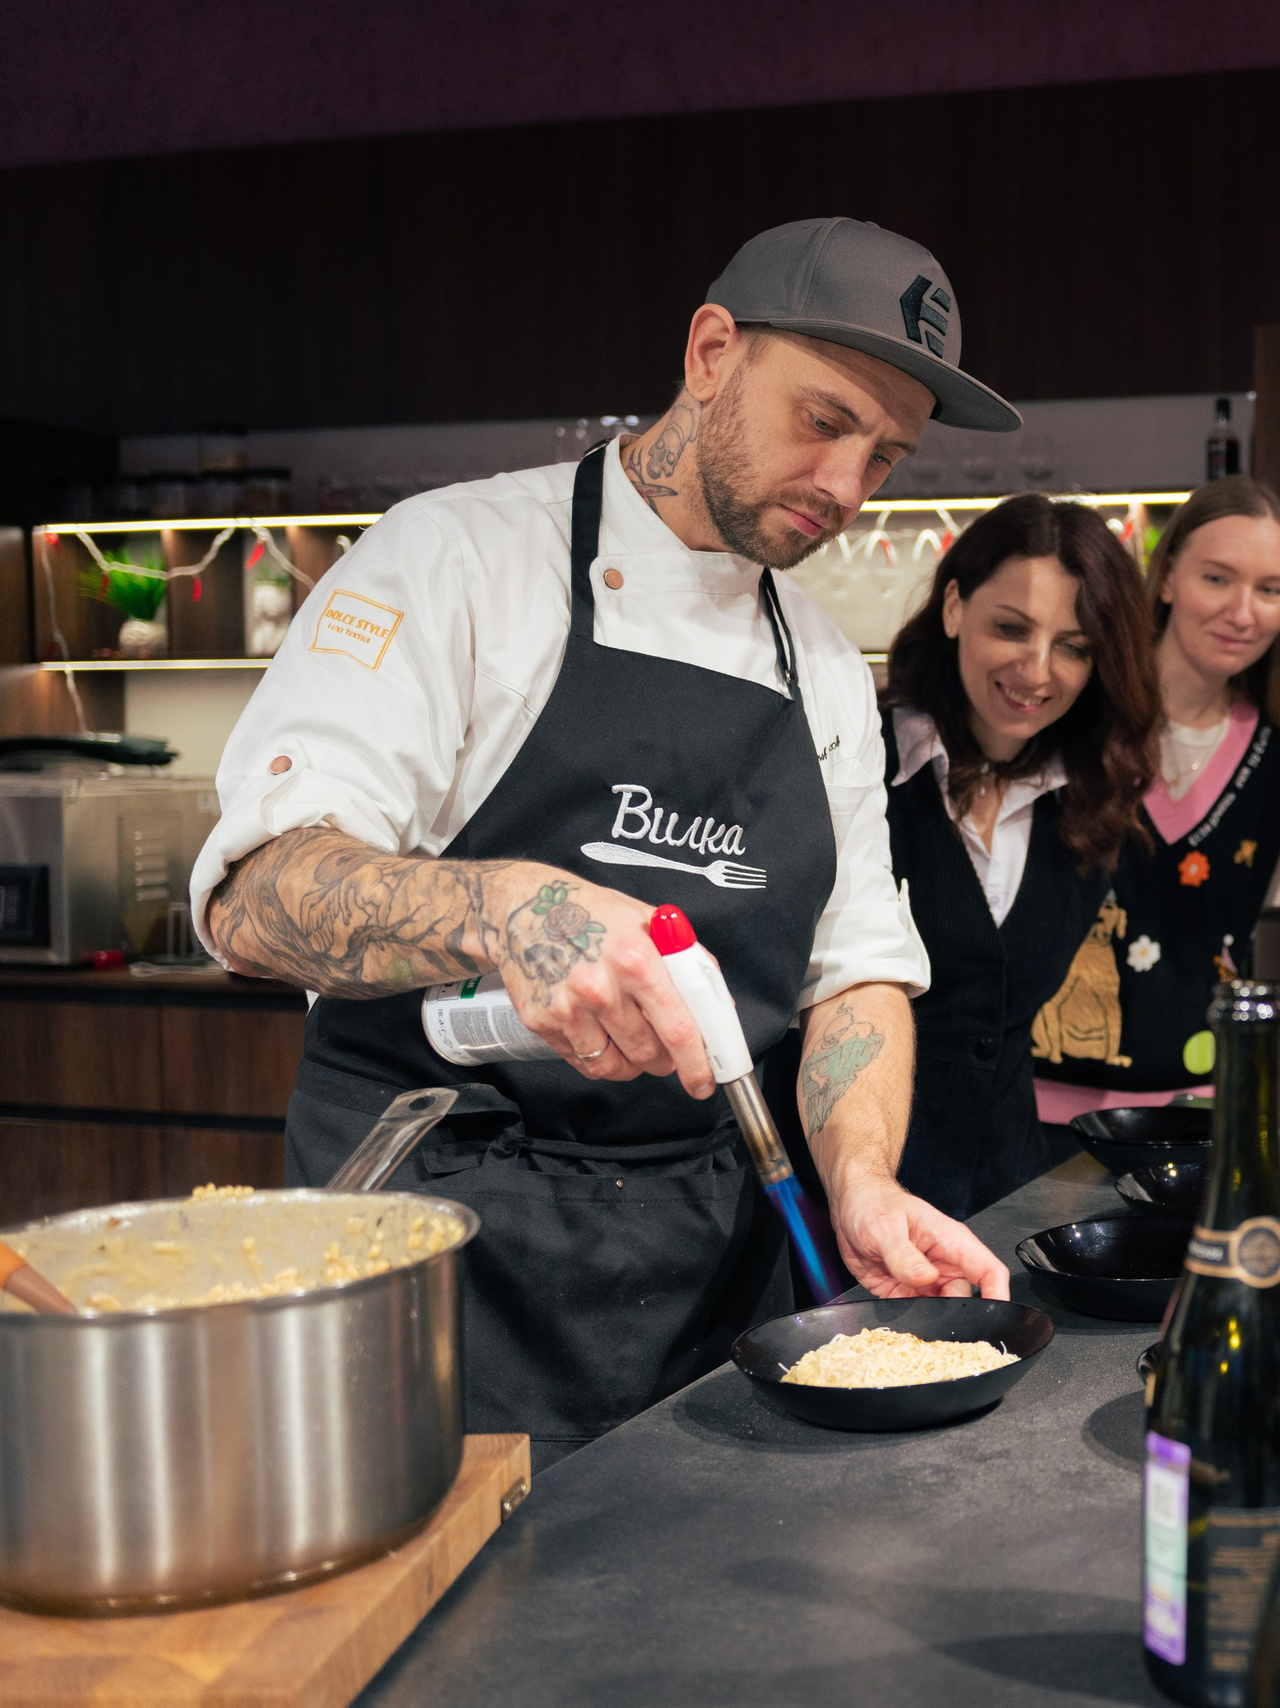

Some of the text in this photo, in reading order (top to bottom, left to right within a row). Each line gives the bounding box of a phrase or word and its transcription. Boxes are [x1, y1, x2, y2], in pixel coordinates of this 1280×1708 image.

[325, 609, 390, 638] DOLCE STYLE
[611, 783, 747, 856] Вилка
